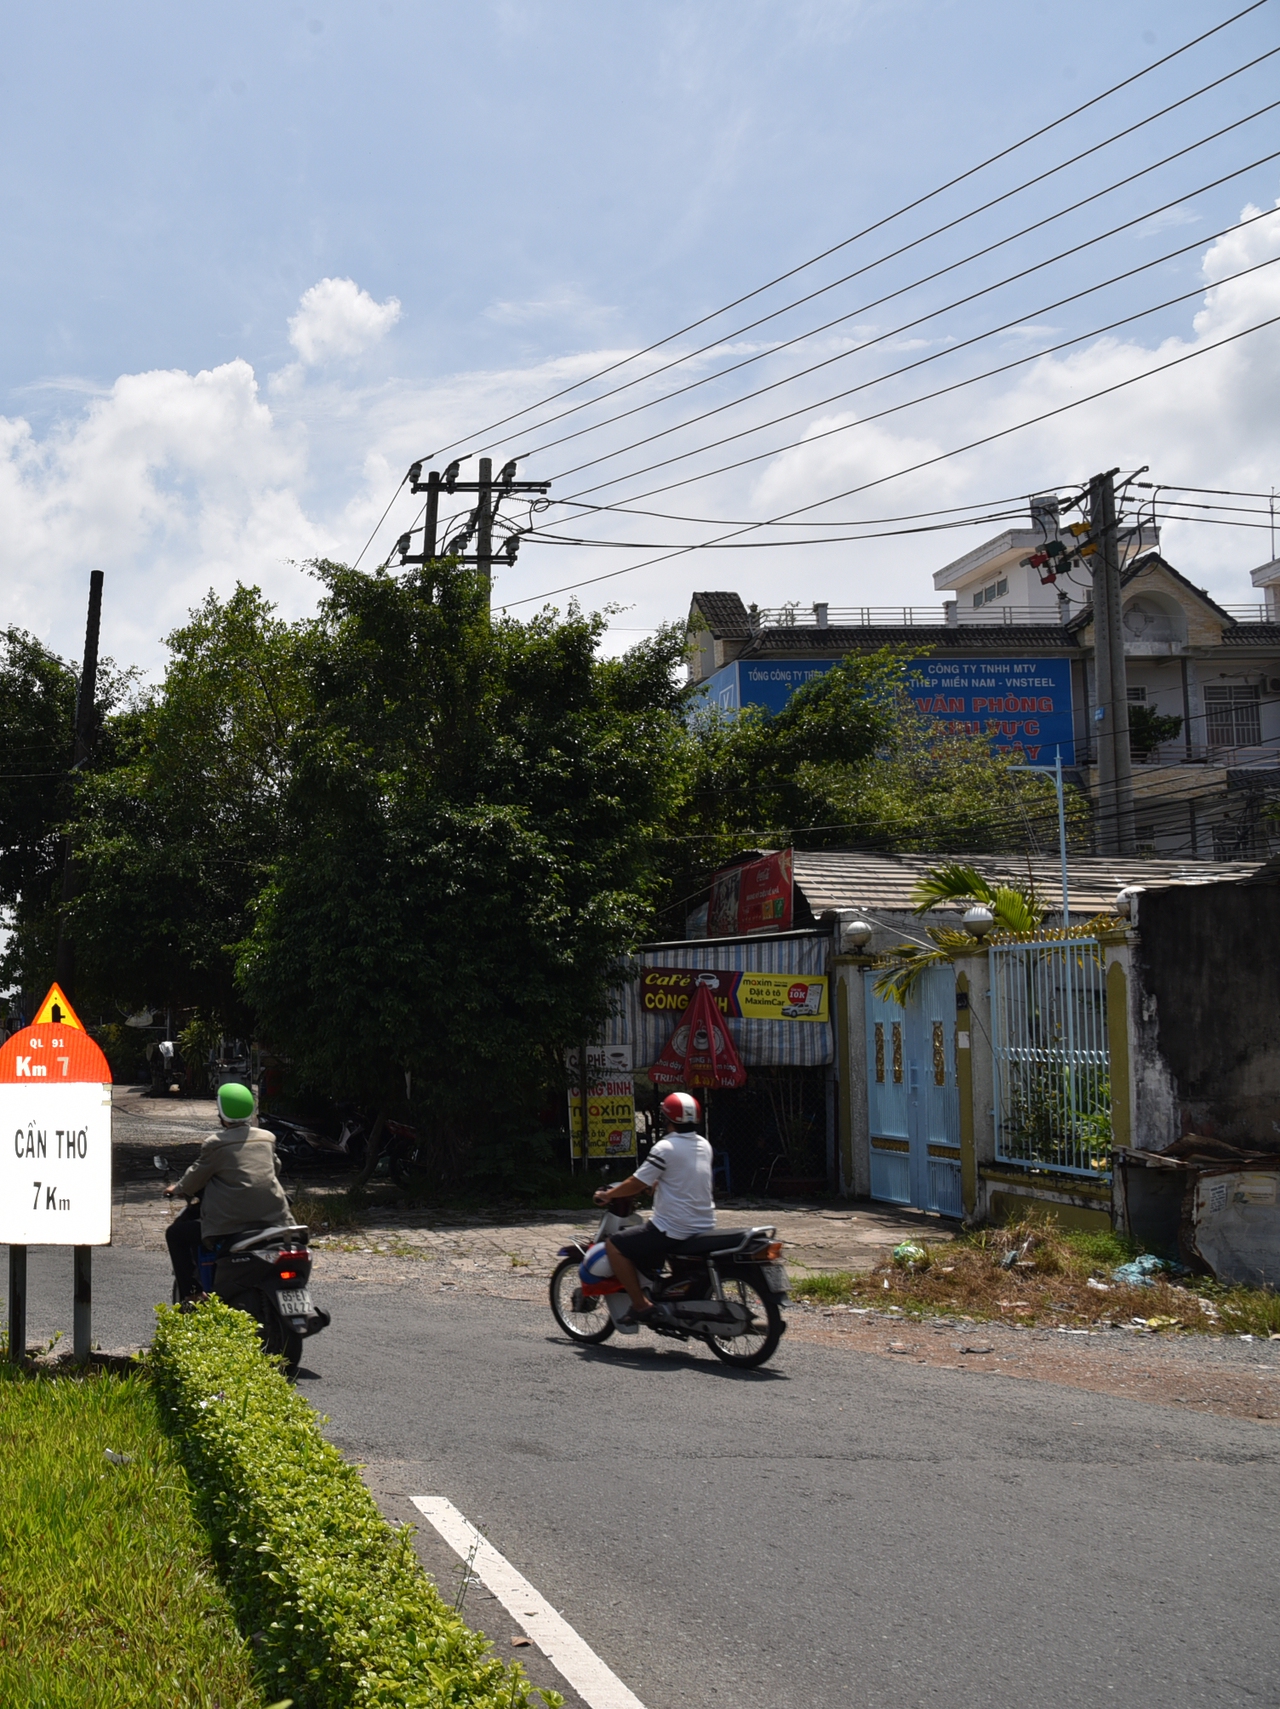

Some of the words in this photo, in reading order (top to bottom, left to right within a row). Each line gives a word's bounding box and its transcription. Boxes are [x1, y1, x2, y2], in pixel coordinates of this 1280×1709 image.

[748, 667, 768, 681] TỔNG
[770, 668, 791, 681] CÔNG
[793, 671, 802, 681] TY
[928, 663, 959, 674] CÔNG
[962, 664, 977, 673] TY
[980, 664, 1010, 673] TNHH
[1014, 664, 1036, 673] MTV
[909, 674, 938, 687] THÉP
[942, 676, 968, 687] MIỀN
[972, 678, 995, 687] NAM
[1005, 678, 1055, 687] VNSTEEL
[916, 693, 965, 713] VĂN
[972, 692, 1054, 713] PHÒNG
[743, 978, 772, 987] maxim
[749, 988, 764, 997] Đặt
[765, 988, 771, 996] ô
[645, 989, 689, 1010] CÔNG
[745, 997, 785, 1006] MaximCar
[30, 1038, 43, 1049] QL
[52, 1039, 64, 1048] 91
[587, 1050, 606, 1066] PHÊ
[16, 1056, 47, 1077] Km
[57, 1057, 69, 1076] 7
[571, 1082, 604, 1097] CNG
[15, 1119, 47, 1158] CẦN
[55, 1125, 88, 1159] THƠ
[282, 1290, 305, 1302] 65-E1
